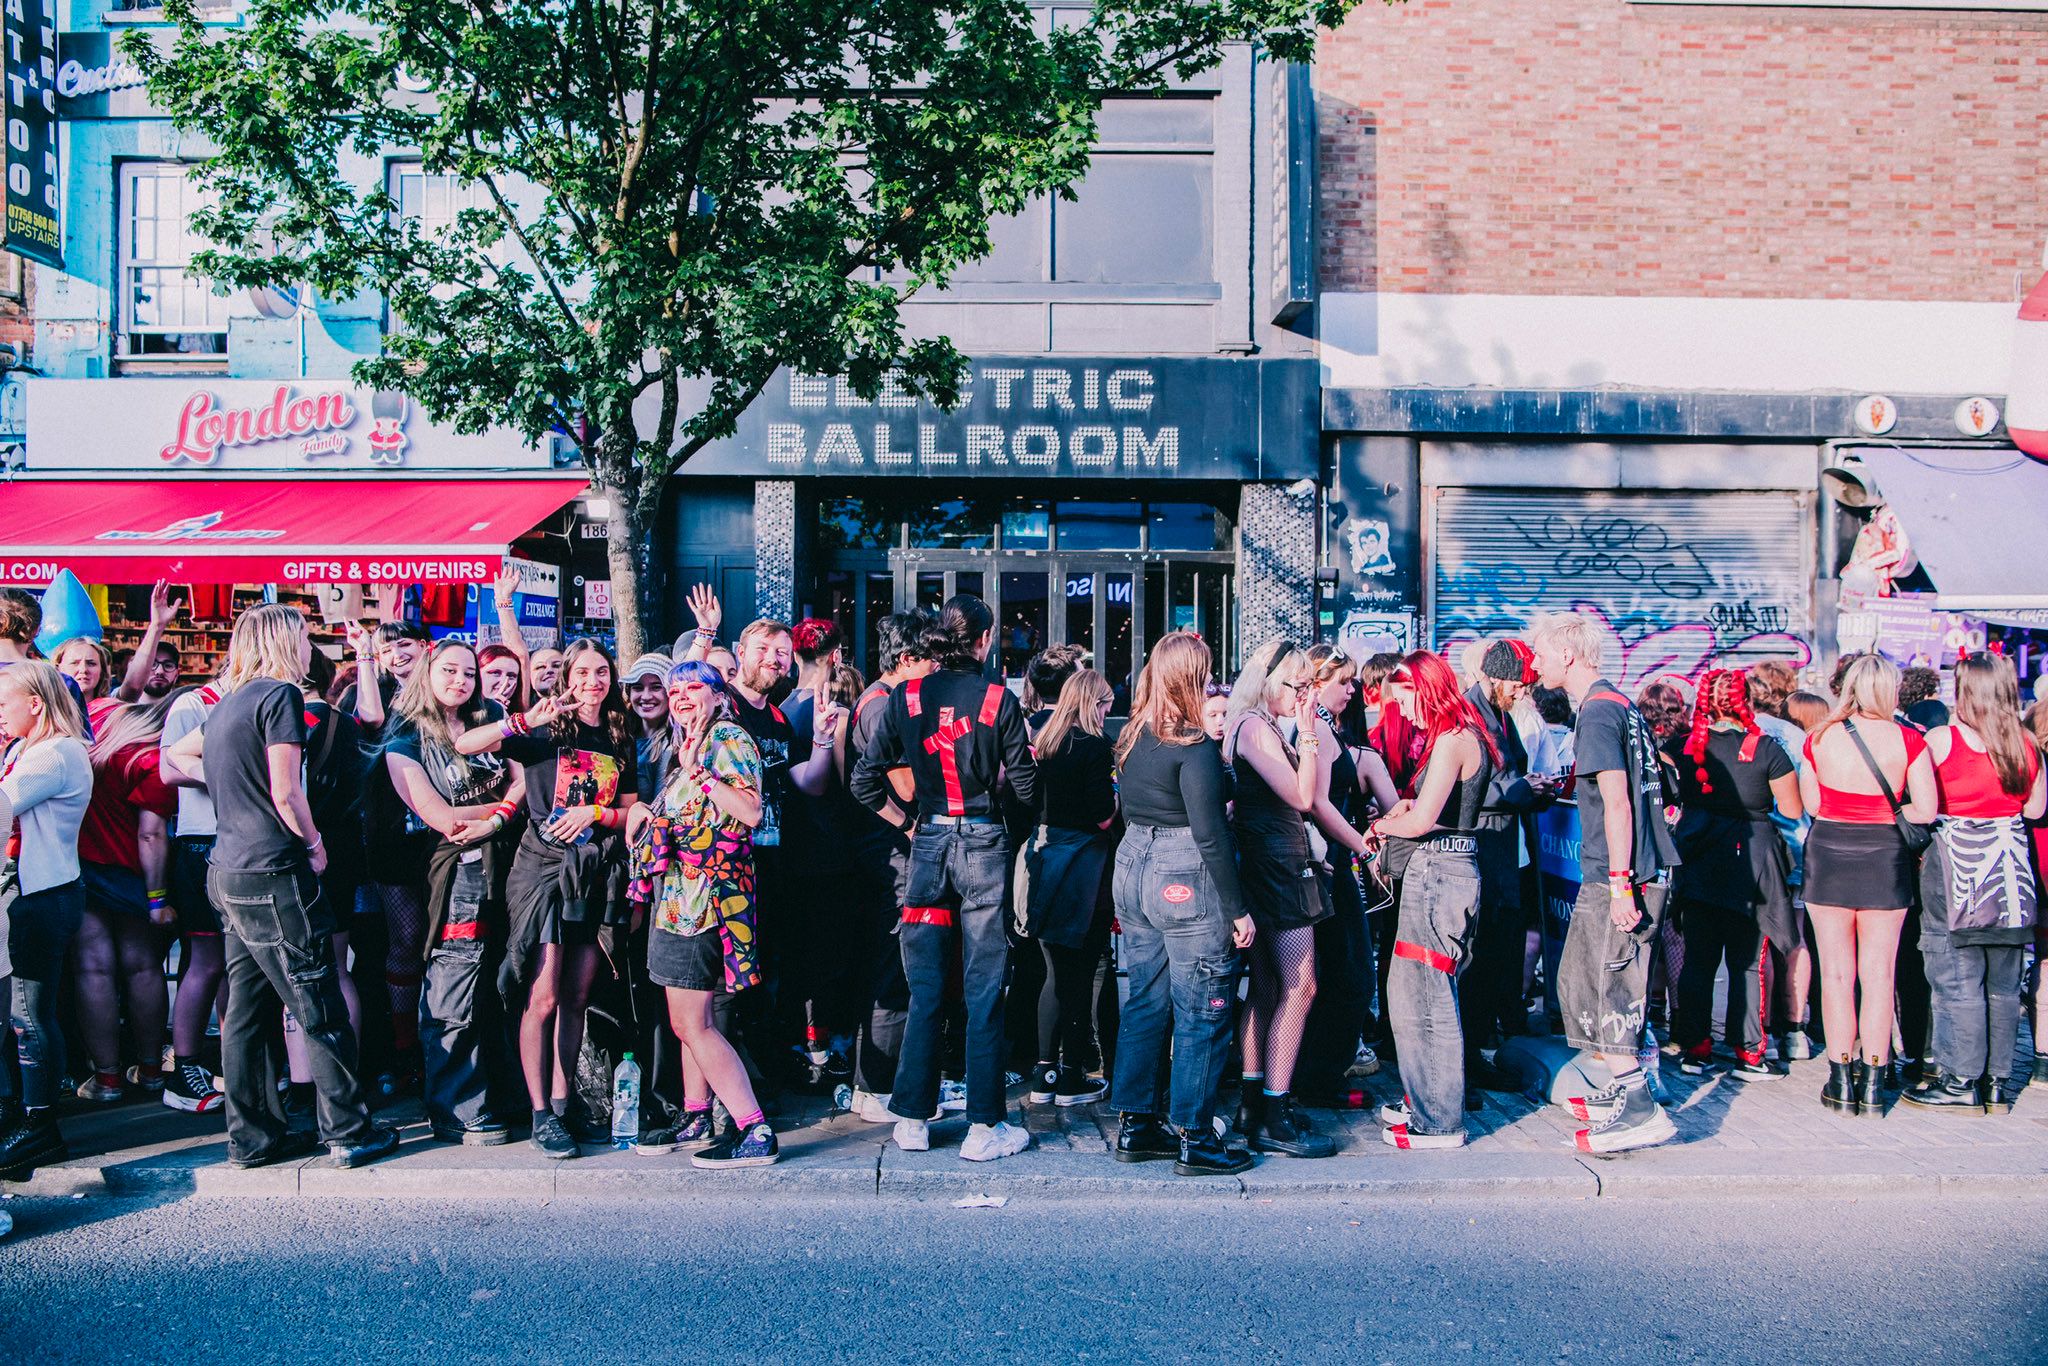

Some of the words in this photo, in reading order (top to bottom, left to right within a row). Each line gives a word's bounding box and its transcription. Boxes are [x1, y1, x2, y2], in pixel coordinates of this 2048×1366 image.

[9, 218, 60, 249] UPSTAIRS
[160, 384, 352, 463] London
[300, 431, 345, 456] Family
[768, 423, 1179, 467] BALLROOM
[584, 524, 608, 538] 186
[283, 562, 343, 580] GIFTS
[348, 562, 363, 580] &
[368, 562, 487, 580] SOUVENIRS
[525, 602, 556, 618] EXCHANGE
